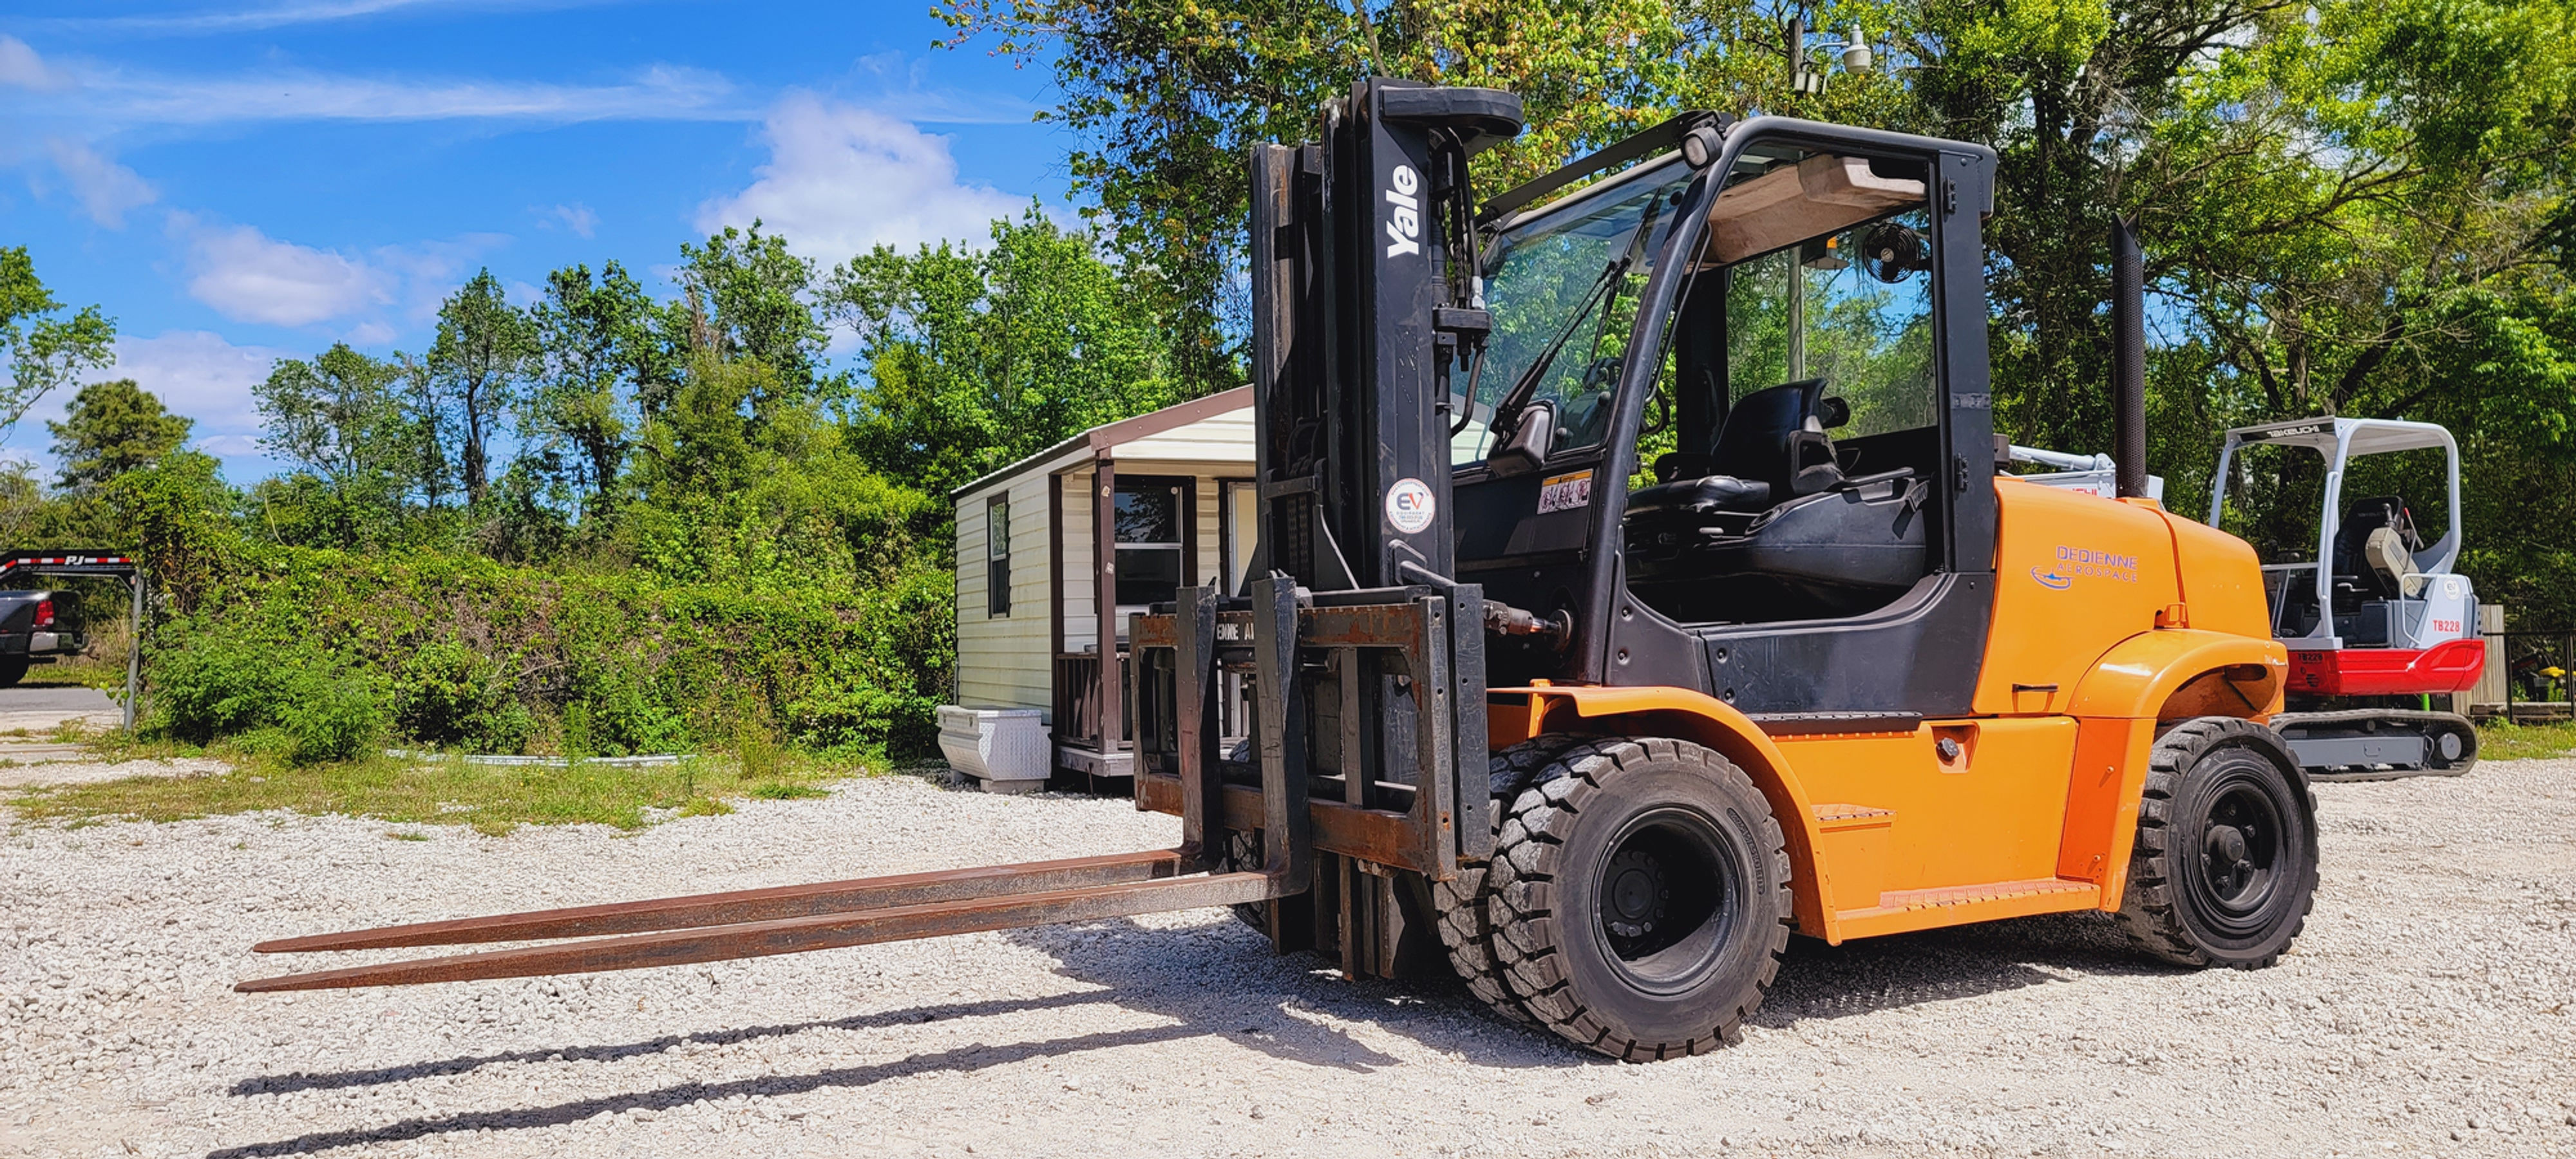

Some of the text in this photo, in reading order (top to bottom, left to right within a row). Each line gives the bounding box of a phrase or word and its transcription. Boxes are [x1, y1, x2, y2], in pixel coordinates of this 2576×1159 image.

[1386, 165, 1419, 258] Yale
[2267, 425, 2320, 438] TAKEUCHI
[1396, 492, 1425, 510] EV
[64, 555, 84, 565] PJ
[2057, 545, 2137, 570] DEDIENNE
[2057, 562, 2137, 583] AEROSPACE
[2433, 619, 2461, 632] TB228
